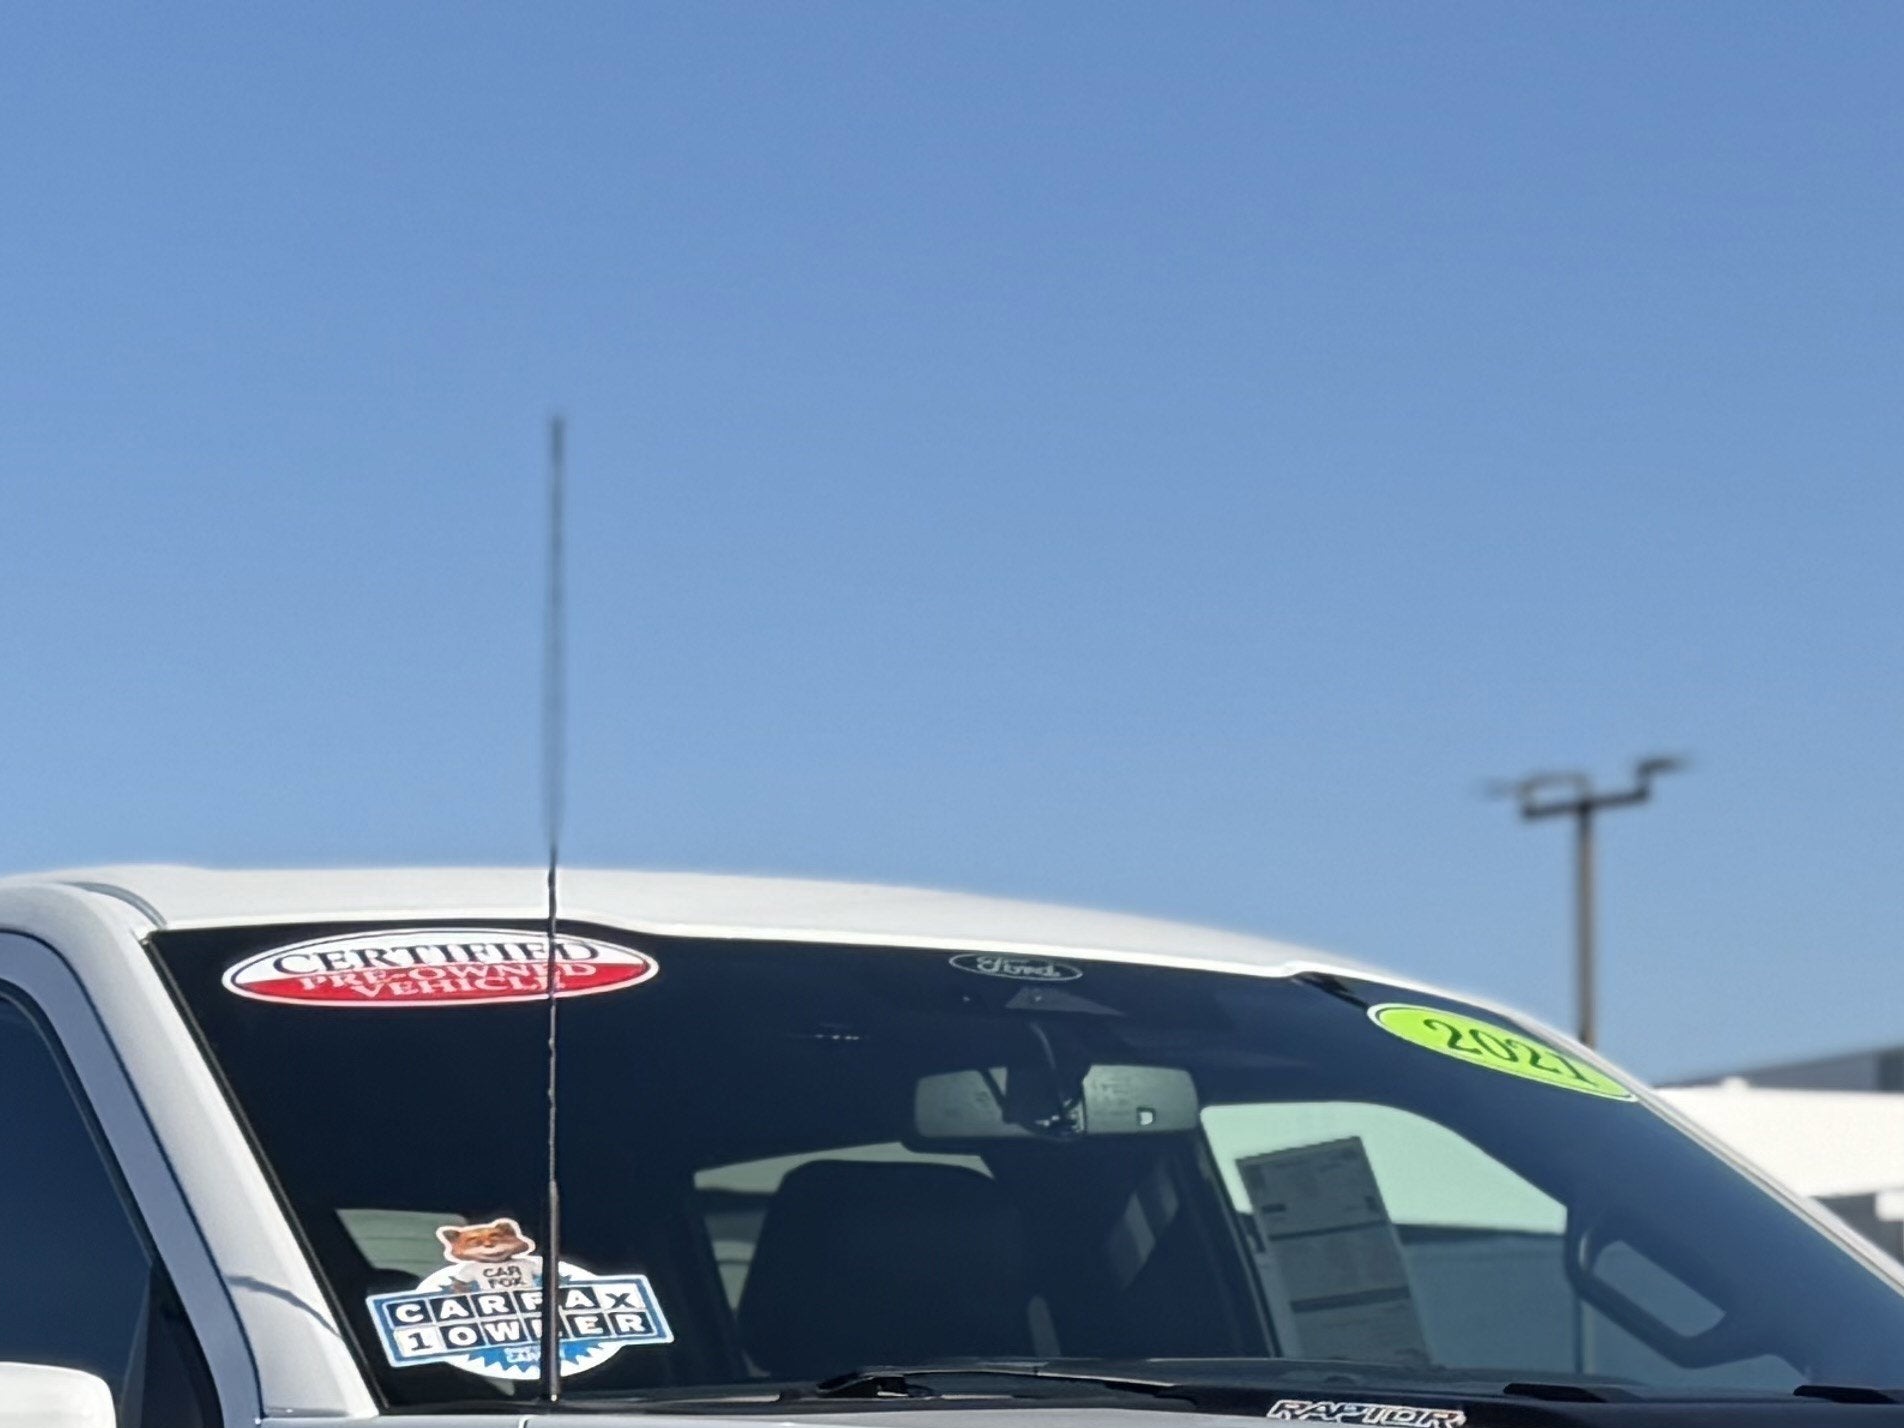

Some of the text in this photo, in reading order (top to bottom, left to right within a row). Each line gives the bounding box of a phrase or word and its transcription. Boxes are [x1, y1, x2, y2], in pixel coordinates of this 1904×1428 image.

[271, 939, 600, 977] CERTIFIED
[975, 955, 1062, 978] Ford
[297, 962, 599, 992] PRE-OWNED
[348, 974, 567, 999] VEHICLE
[395, 1287, 634, 1325] CARFAX
[406, 1330, 434, 1352] 1
